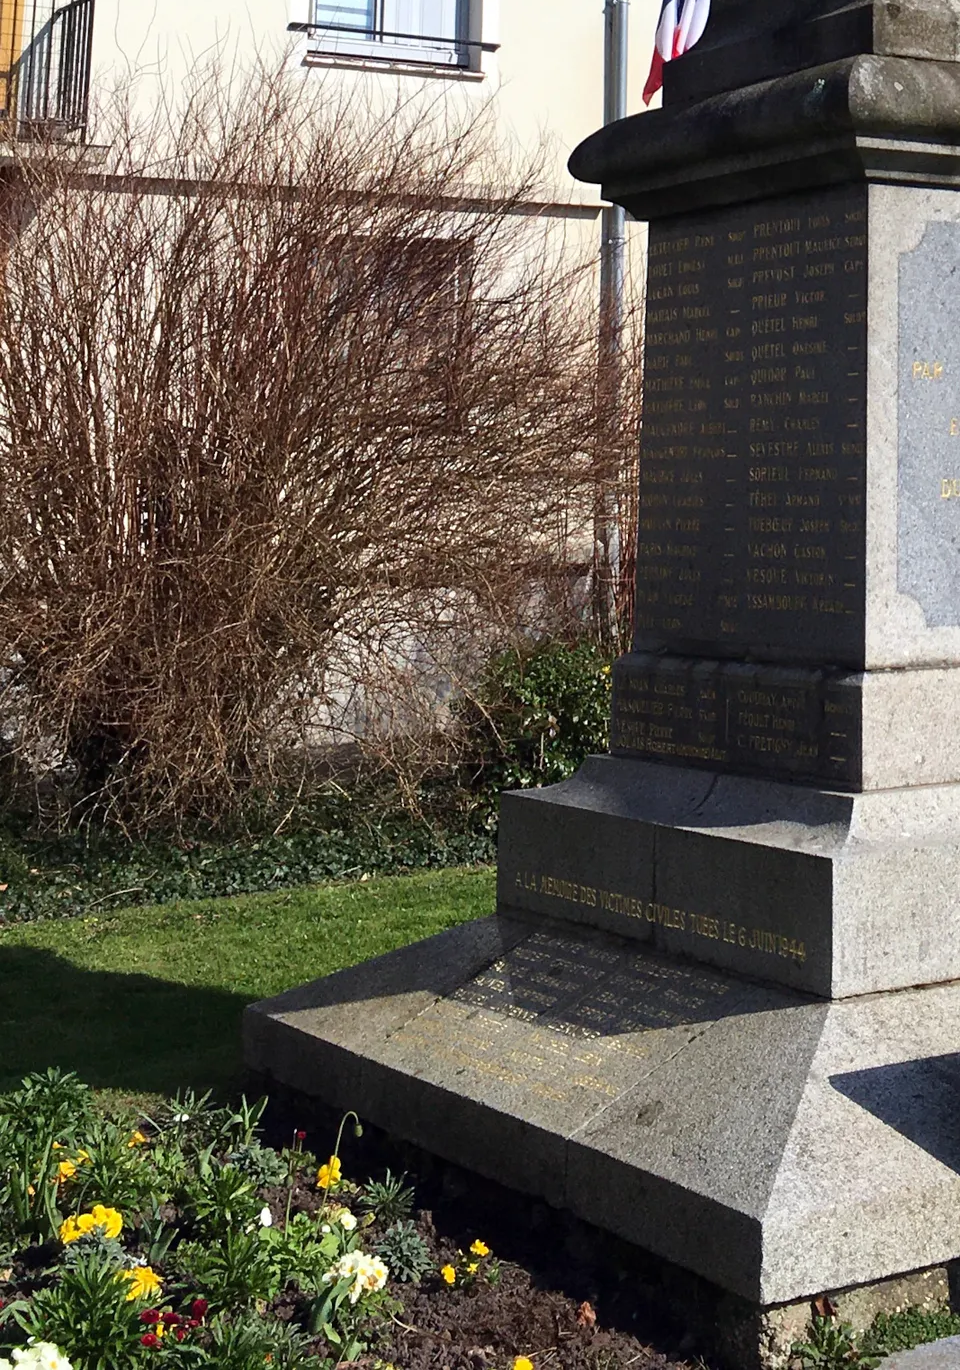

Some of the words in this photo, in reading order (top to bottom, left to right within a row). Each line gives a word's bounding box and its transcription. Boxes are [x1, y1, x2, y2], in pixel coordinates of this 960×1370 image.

[752, 240, 800, 261] PRENTOUT
[805, 236, 841, 255] MAURICE
[803, 263, 835, 278] JOSEPH
[752, 293, 787, 310] PRIEUR
[795, 290, 826, 304] VICTOR
[912, 361, 943, 381] PAR
[747, 542, 787, 559] VACHON
[524, 871, 537, 891] LA
[580, 885, 597, 908] DES
[598, 888, 643, 919] VICTIMES
[645, 902, 686, 931] CIVILES
[723, 921, 735, 944] LE
[738, 926, 747, 947] 6
[748, 929, 777, 955] JUIN
[778, 935, 807, 963] 1944
